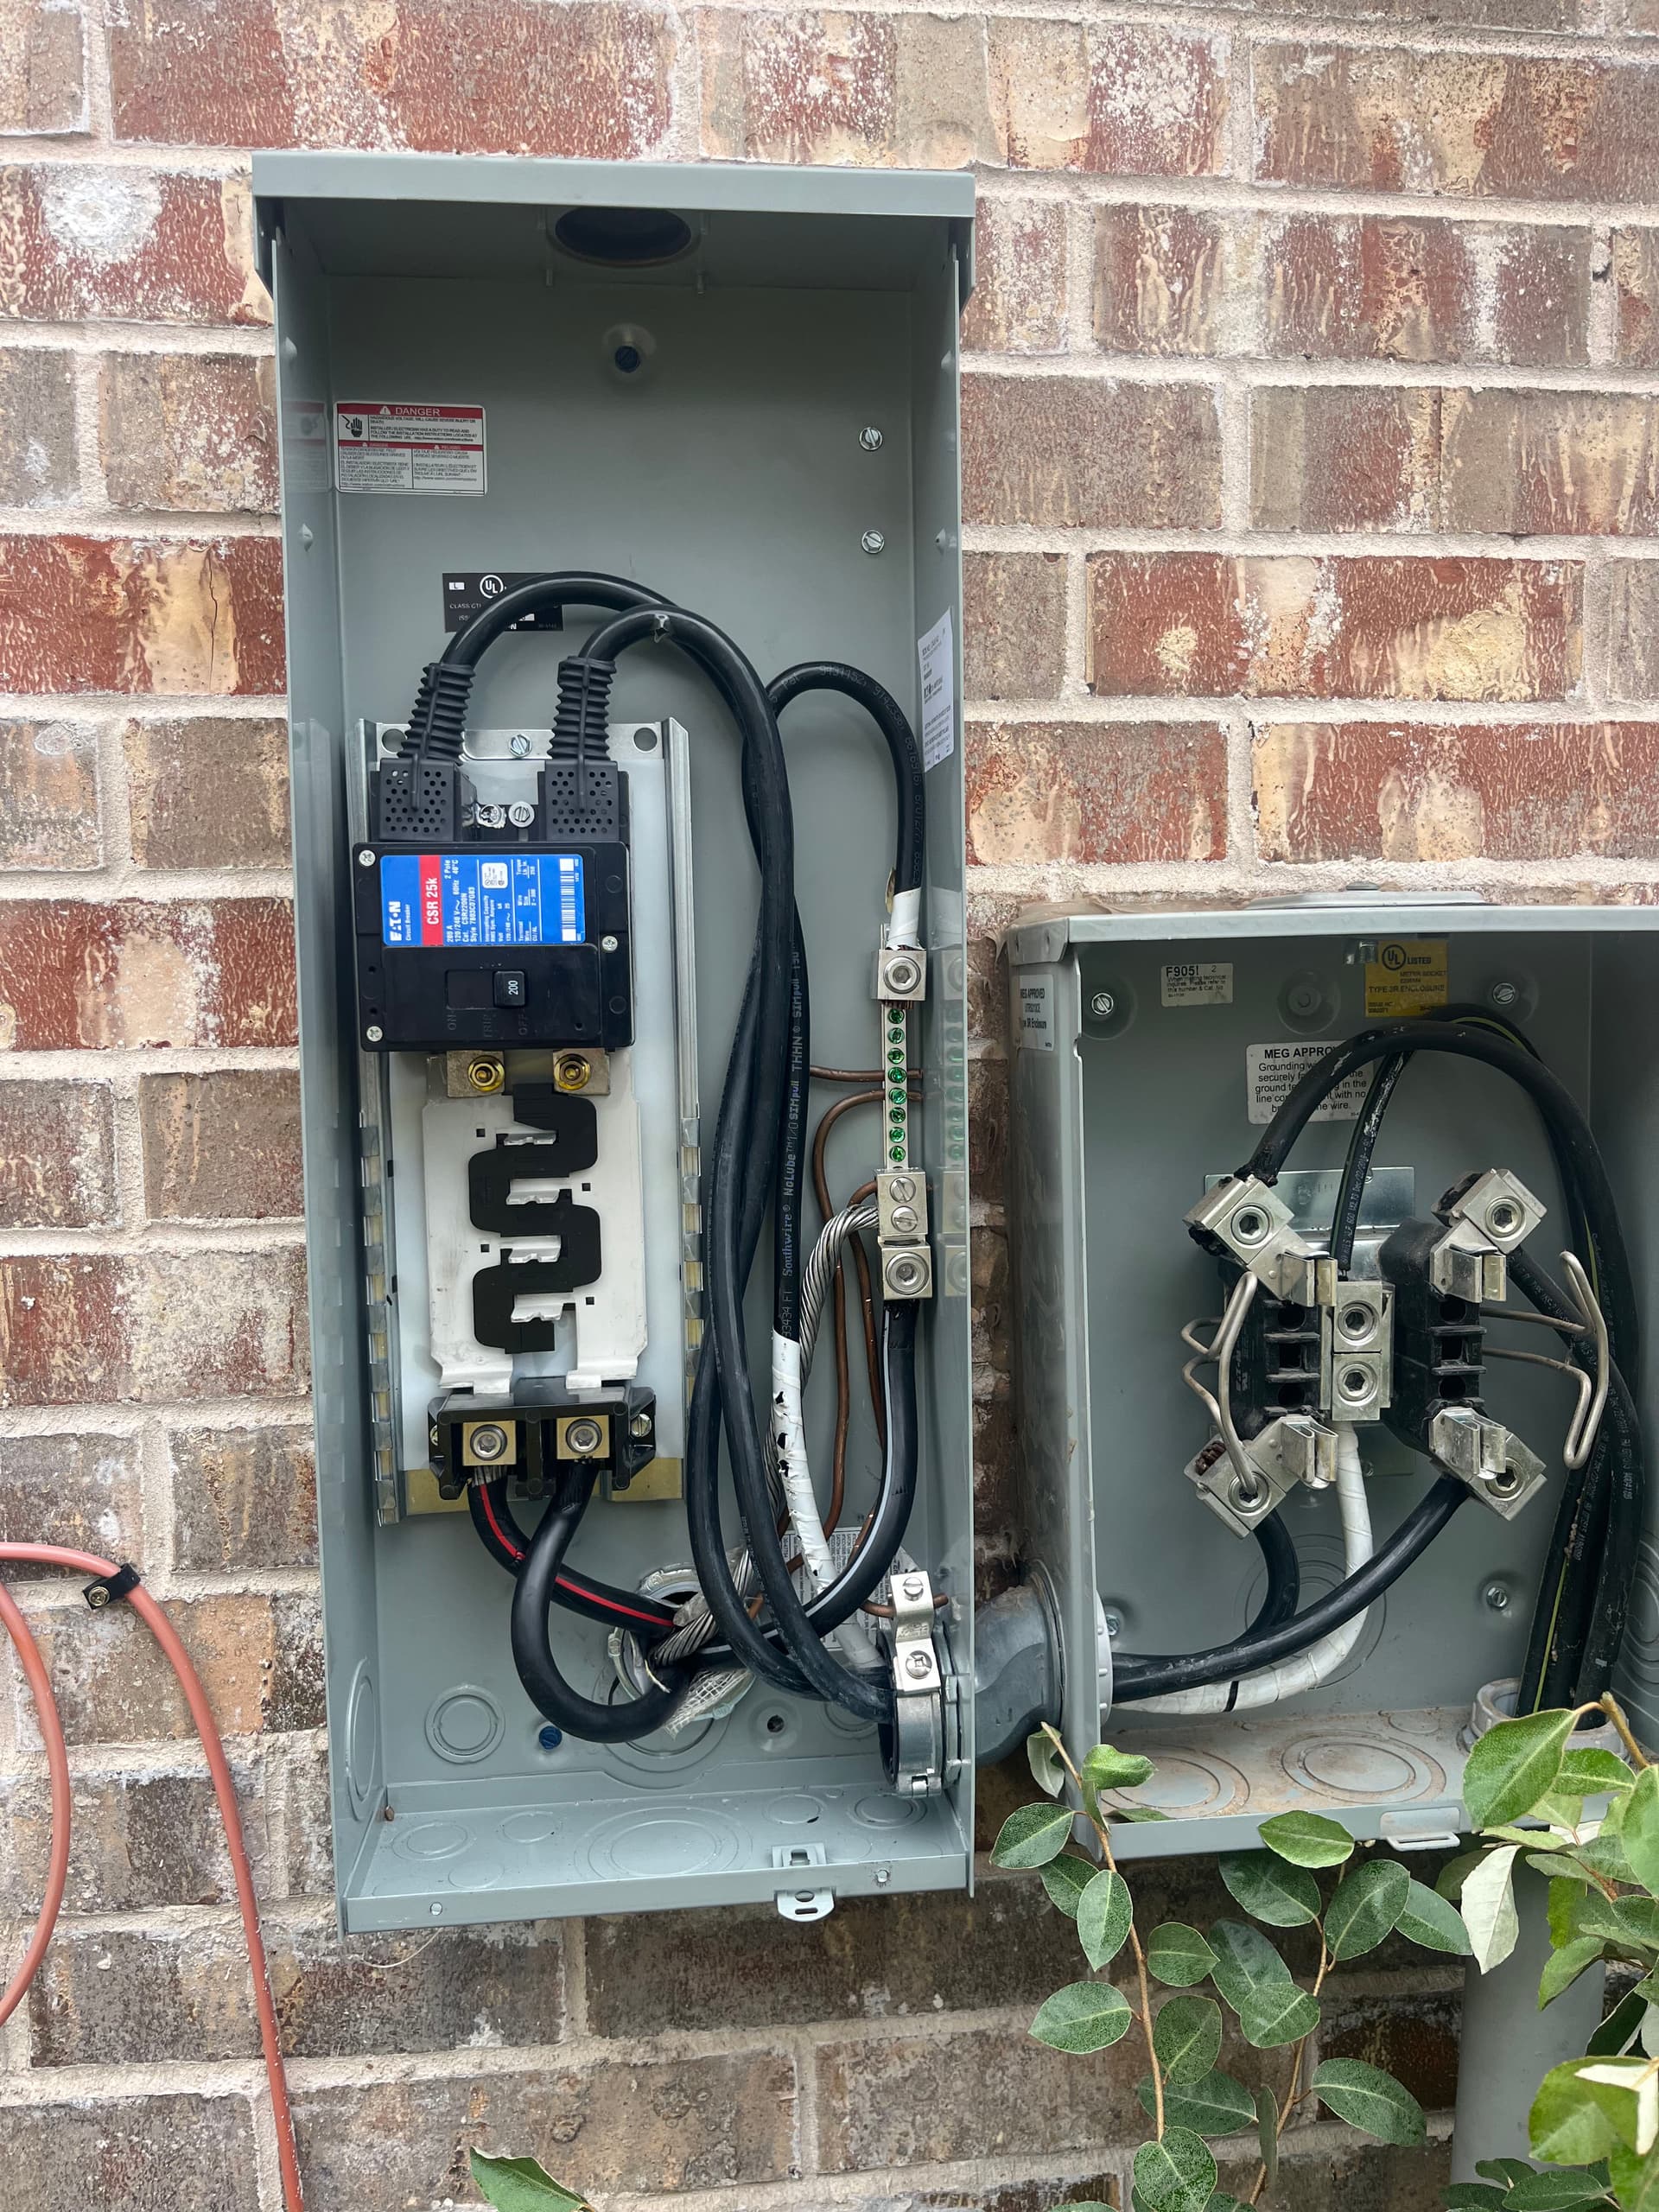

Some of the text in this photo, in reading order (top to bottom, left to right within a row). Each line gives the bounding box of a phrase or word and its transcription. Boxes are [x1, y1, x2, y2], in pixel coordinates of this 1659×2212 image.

[395, 407, 441, 416] DANGER
[485, 580, 499, 594] UL
[425, 878, 439, 925] CSR 25k
[469, 926, 478, 942] Style
[1211, 964, 1217, 973] 2
[508, 980, 518, 995] 200
[791, 978, 803, 1018] SIMpull
[1264, 1046, 1336, 1059] MEG APPRO
[1258, 1063, 1305, 1072] Grounding
[1258, 1072, 1295, 1083] securely
[1255, 1083, 1287, 1094] ground
[1342, 1079, 1367, 1089] in the
[788, 1079, 800, 1121] SIMpull
[1256, 1094, 1272, 1103] line
[1334, 1090, 1352, 1099] with
